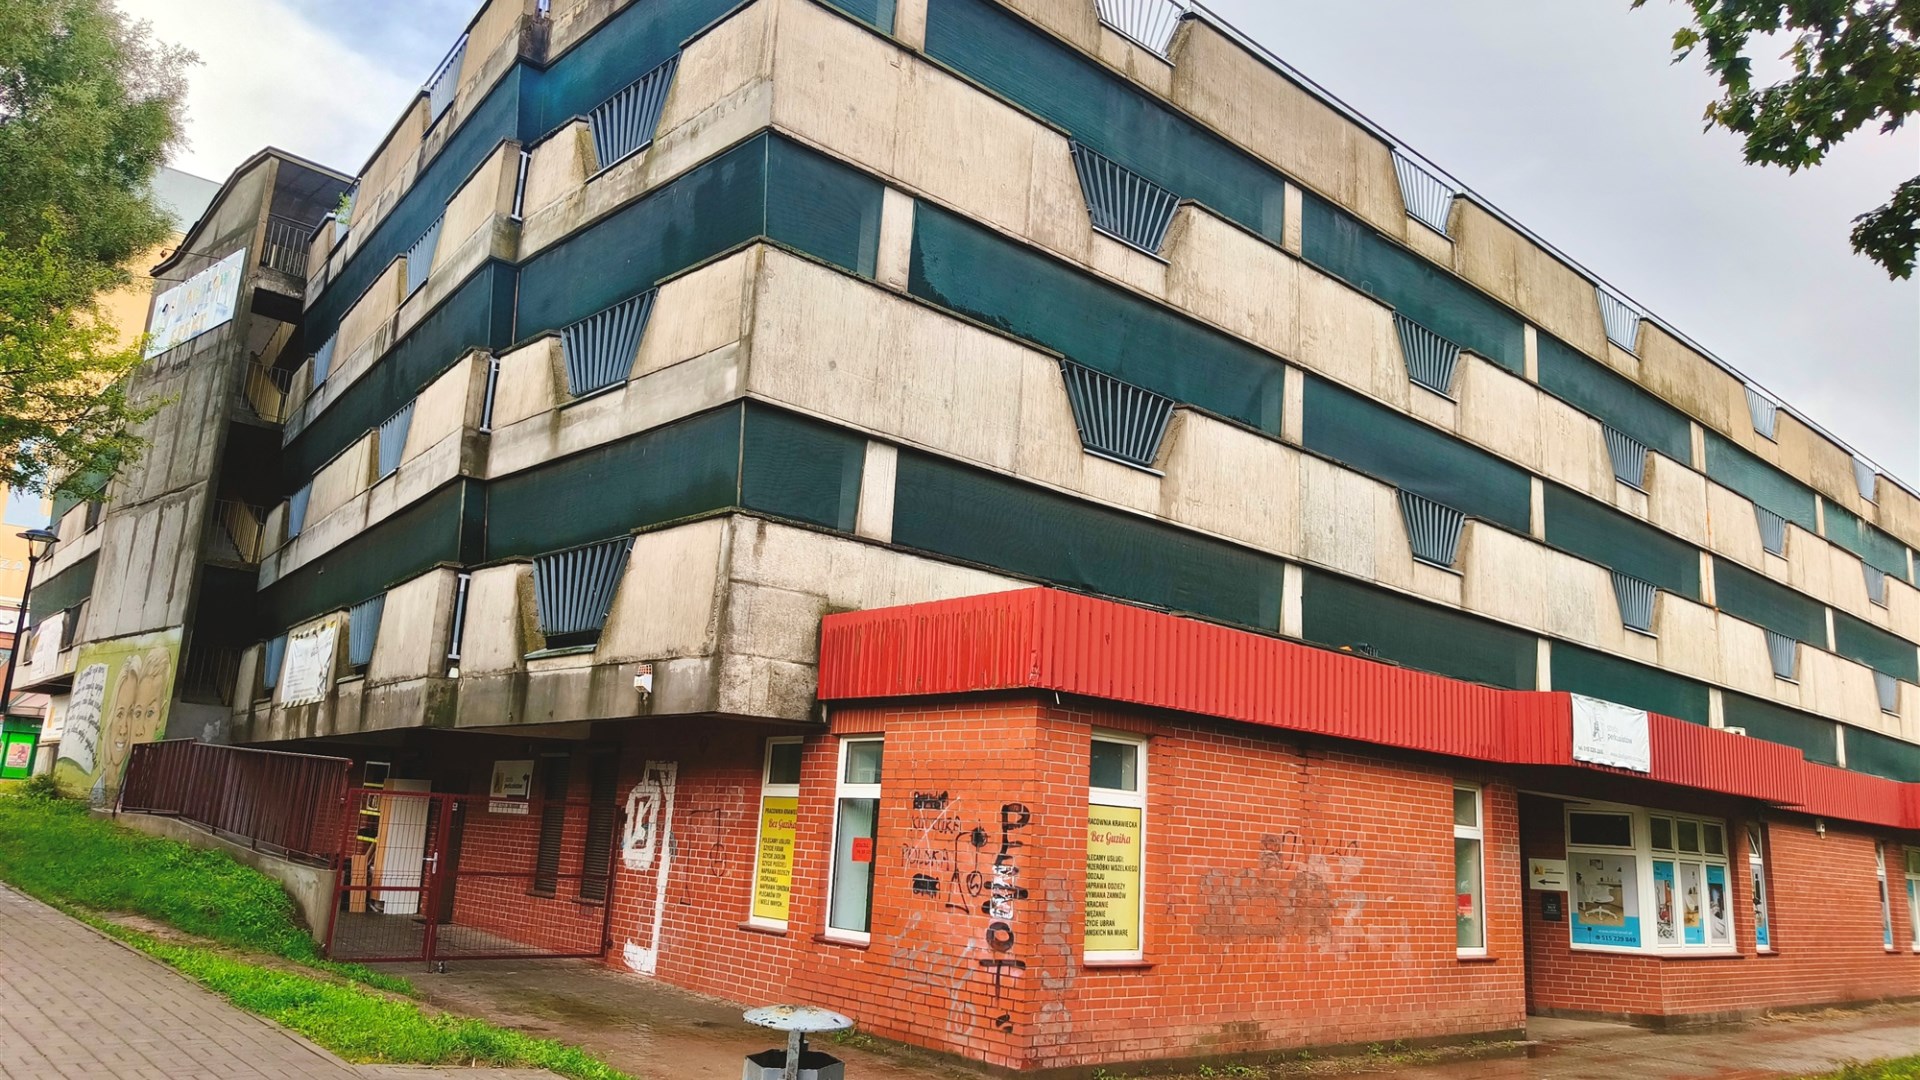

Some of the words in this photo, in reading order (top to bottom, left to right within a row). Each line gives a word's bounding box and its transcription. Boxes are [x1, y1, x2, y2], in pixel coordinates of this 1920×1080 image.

[1112, 820, 1137, 828] KRAWIECKA
[1091, 831, 1104, 843] Bez
[1105, 831, 1131, 846] Guzika
